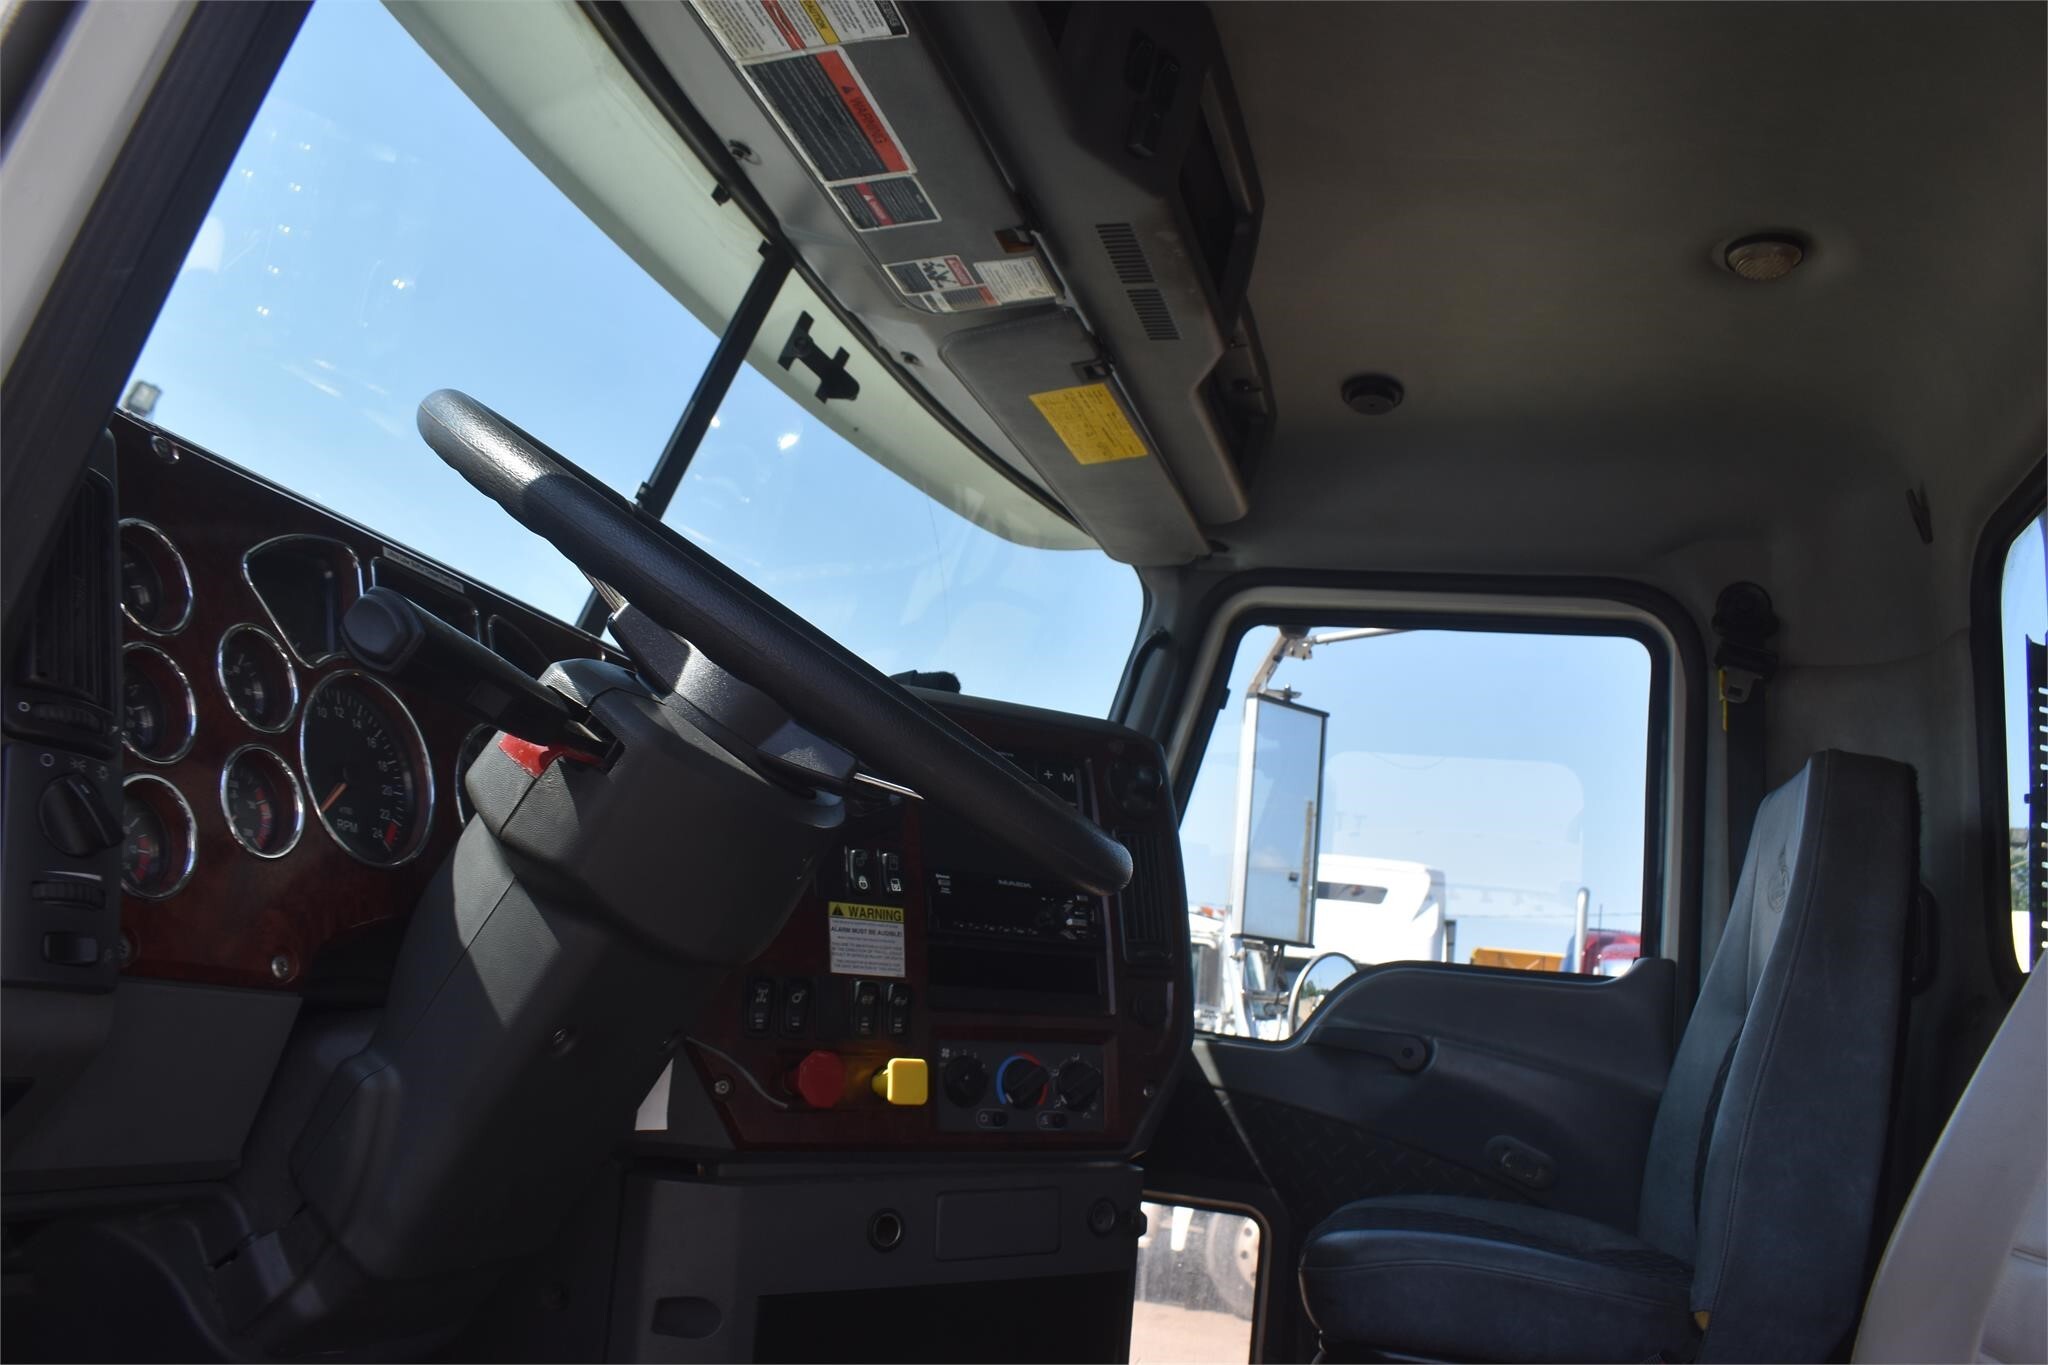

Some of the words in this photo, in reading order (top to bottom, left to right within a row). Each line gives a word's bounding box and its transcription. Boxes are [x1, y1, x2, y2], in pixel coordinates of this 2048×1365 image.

[850, 97, 887, 144] WARNING
[336, 818, 358, 833] RPM
[848, 905, 902, 921] WARNING
